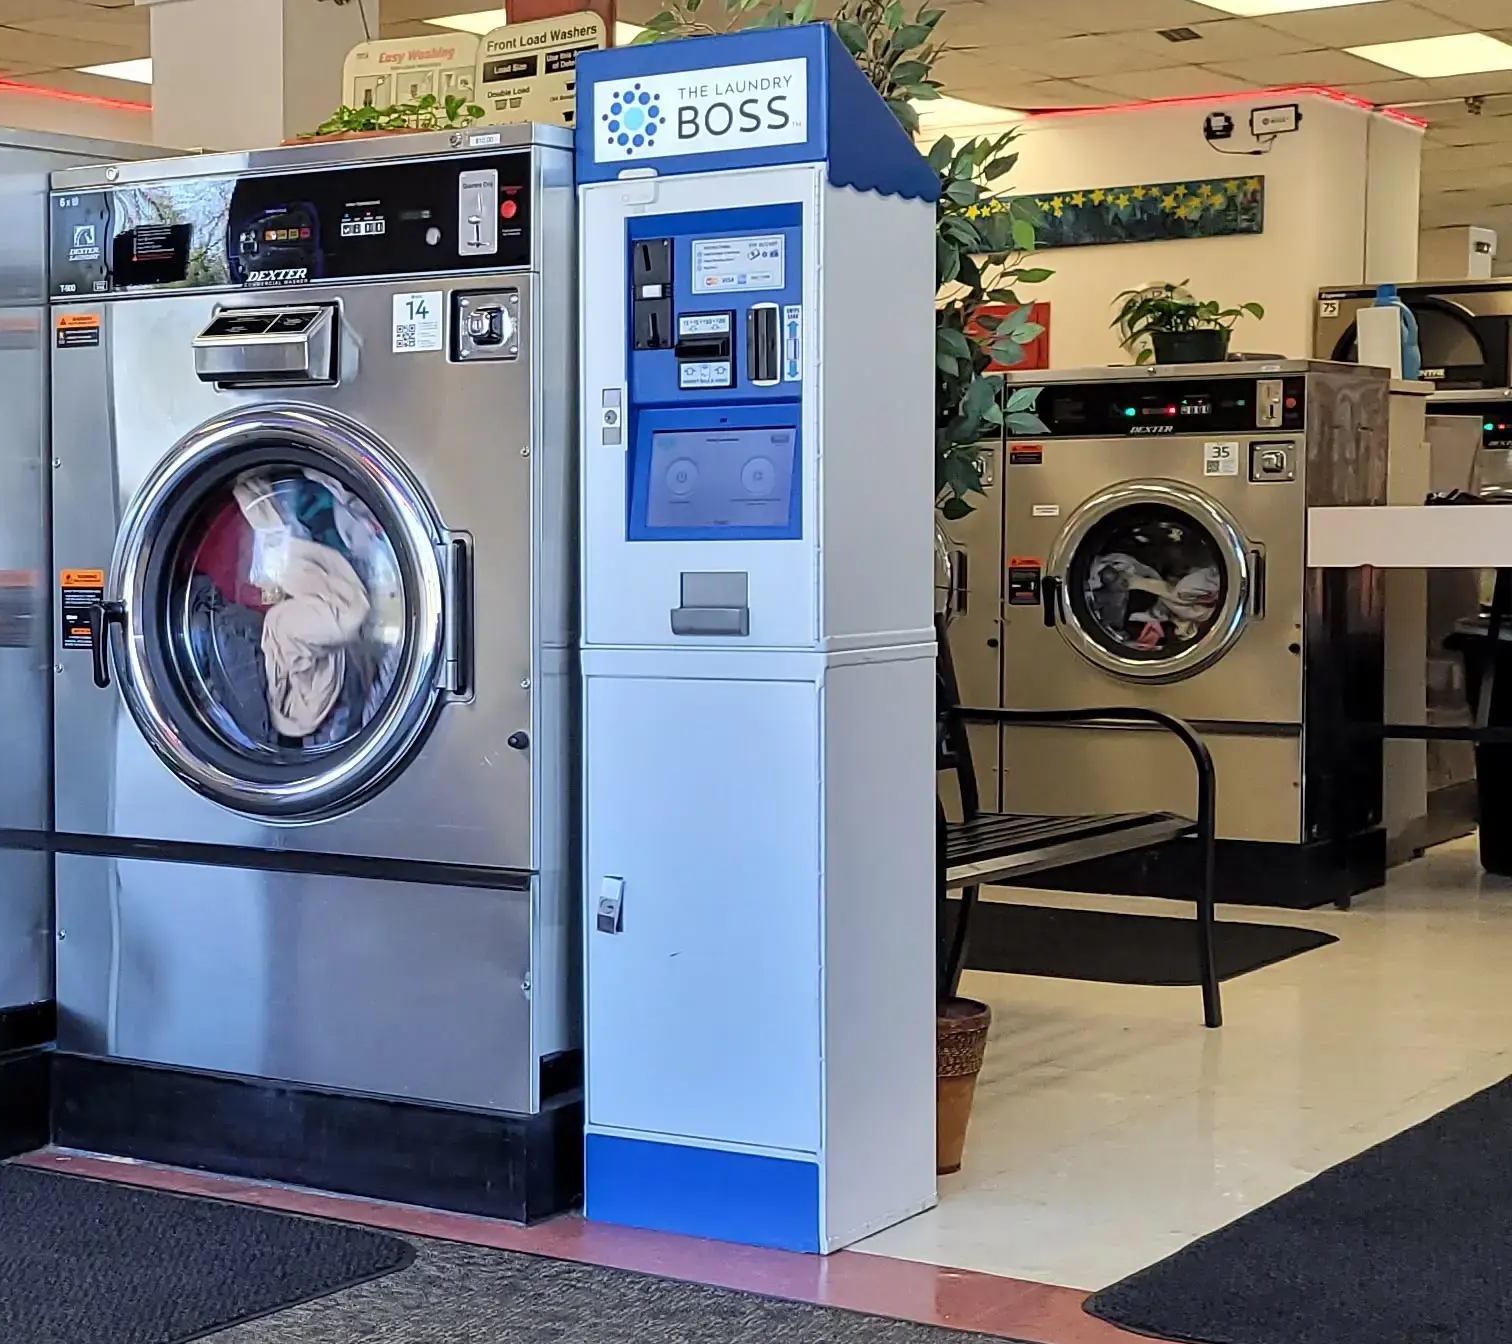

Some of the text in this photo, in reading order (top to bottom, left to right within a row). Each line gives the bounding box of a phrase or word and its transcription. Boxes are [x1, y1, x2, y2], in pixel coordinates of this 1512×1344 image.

[487, 25, 597, 52] Front Load Washers
[378, 52, 405, 64] Easy
[408, 47, 456, 61] Washing
[493, 62, 527, 74] Load Size
[487, 86, 530, 98] Double Load
[677, 74, 793, 100] THE LAUNDRY
[677, 95, 790, 140] BOSS
[245, 268, 308, 282] DEXTER
[405, 299, 430, 321] 14
[1322, 302, 1337, 313] 75
[1129, 425, 1174, 434] DEXTER
[1211, 446, 1230, 459] 35
